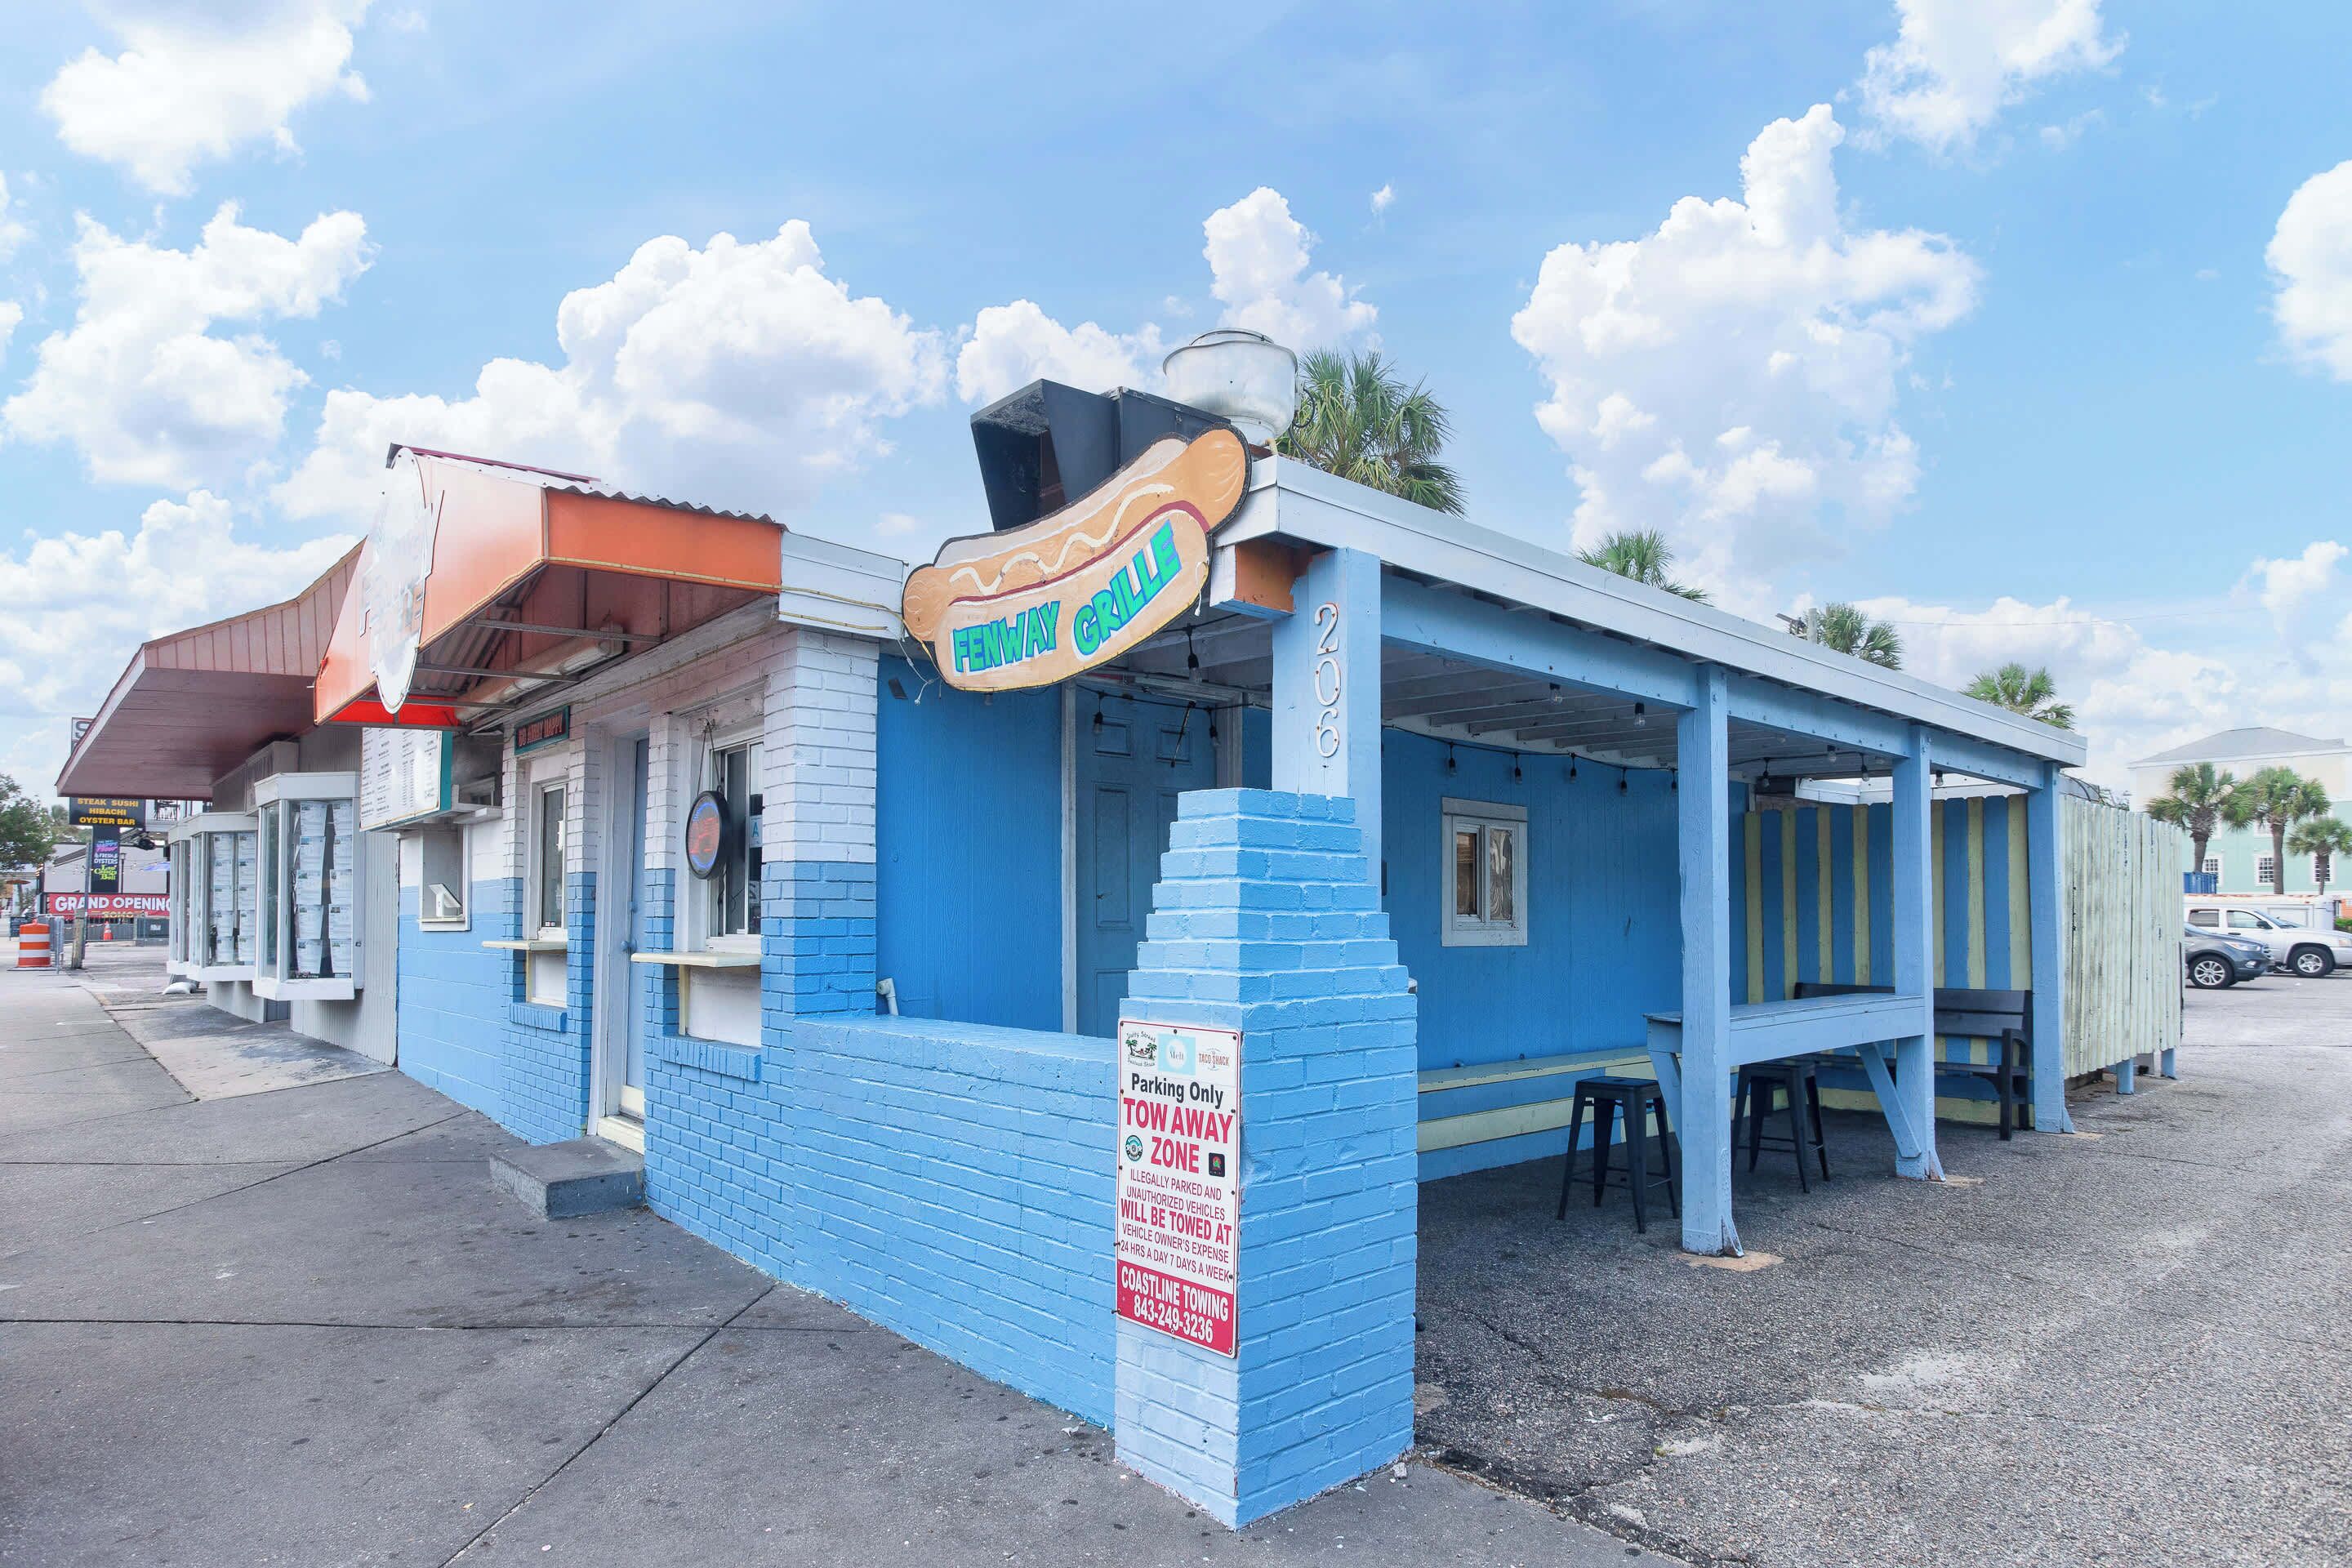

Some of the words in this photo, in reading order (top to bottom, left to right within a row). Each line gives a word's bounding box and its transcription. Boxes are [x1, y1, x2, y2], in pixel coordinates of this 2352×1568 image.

[953, 601, 1060, 672] FENWAY
[1074, 519, 1182, 655] GRILLE
[1314, 604, 1342, 758] 206
[89, 808, 127, 816] HIBACHI
[56, 896, 109, 912] GRAND
[1199, 1054, 1211, 1064] TACO
[1213, 1055, 1229, 1067] SHACK
[1132, 1072, 1184, 1103] Parking
[1190, 1081, 1223, 1109] Only
[1124, 1098, 1168, 1132] TOW
[1171, 1106, 1233, 1143] AWAY
[1151, 1136, 1199, 1174] ZONE
[1127, 1185, 1184, 1210] UNAUTHORIZED
[1187, 1200, 1225, 1221] VEHICLES
[1130, 1169, 1169, 1188] ILLEGALLY
[1171, 1178, 1202, 1196] PARKED
[1205, 1186, 1222, 1200] AND
[1121, 1198, 1147, 1223] WILL
[1152, 1206, 1165, 1228] BE
[1169, 1210, 1212, 1241] TOWED
[1215, 1223, 1232, 1245] AT
[1121, 1240, 1129, 1253] 24
[1130, 1242, 1145, 1258] HRS
[1147, 1248, 1152, 1259] A
[1154, 1250, 1168, 1264] DAY
[1170, 1254, 1174, 1266] 7
[1176, 1256, 1196, 1273] DAYS
[1199, 1263, 1204, 1276] A
[1206, 1264, 1230, 1283] WEEK
[1123, 1223, 1152, 1241] VEHICLE
[1155, 1232, 1190, 1253] OWNER'S
[1192, 1241, 1229, 1263] EXPENSE
[1121, 1266, 1180, 1307] COASTLINE
[1183, 1285, 1228, 1321] TOWING
[1134, 1294, 1213, 1343] 843-249-3236
